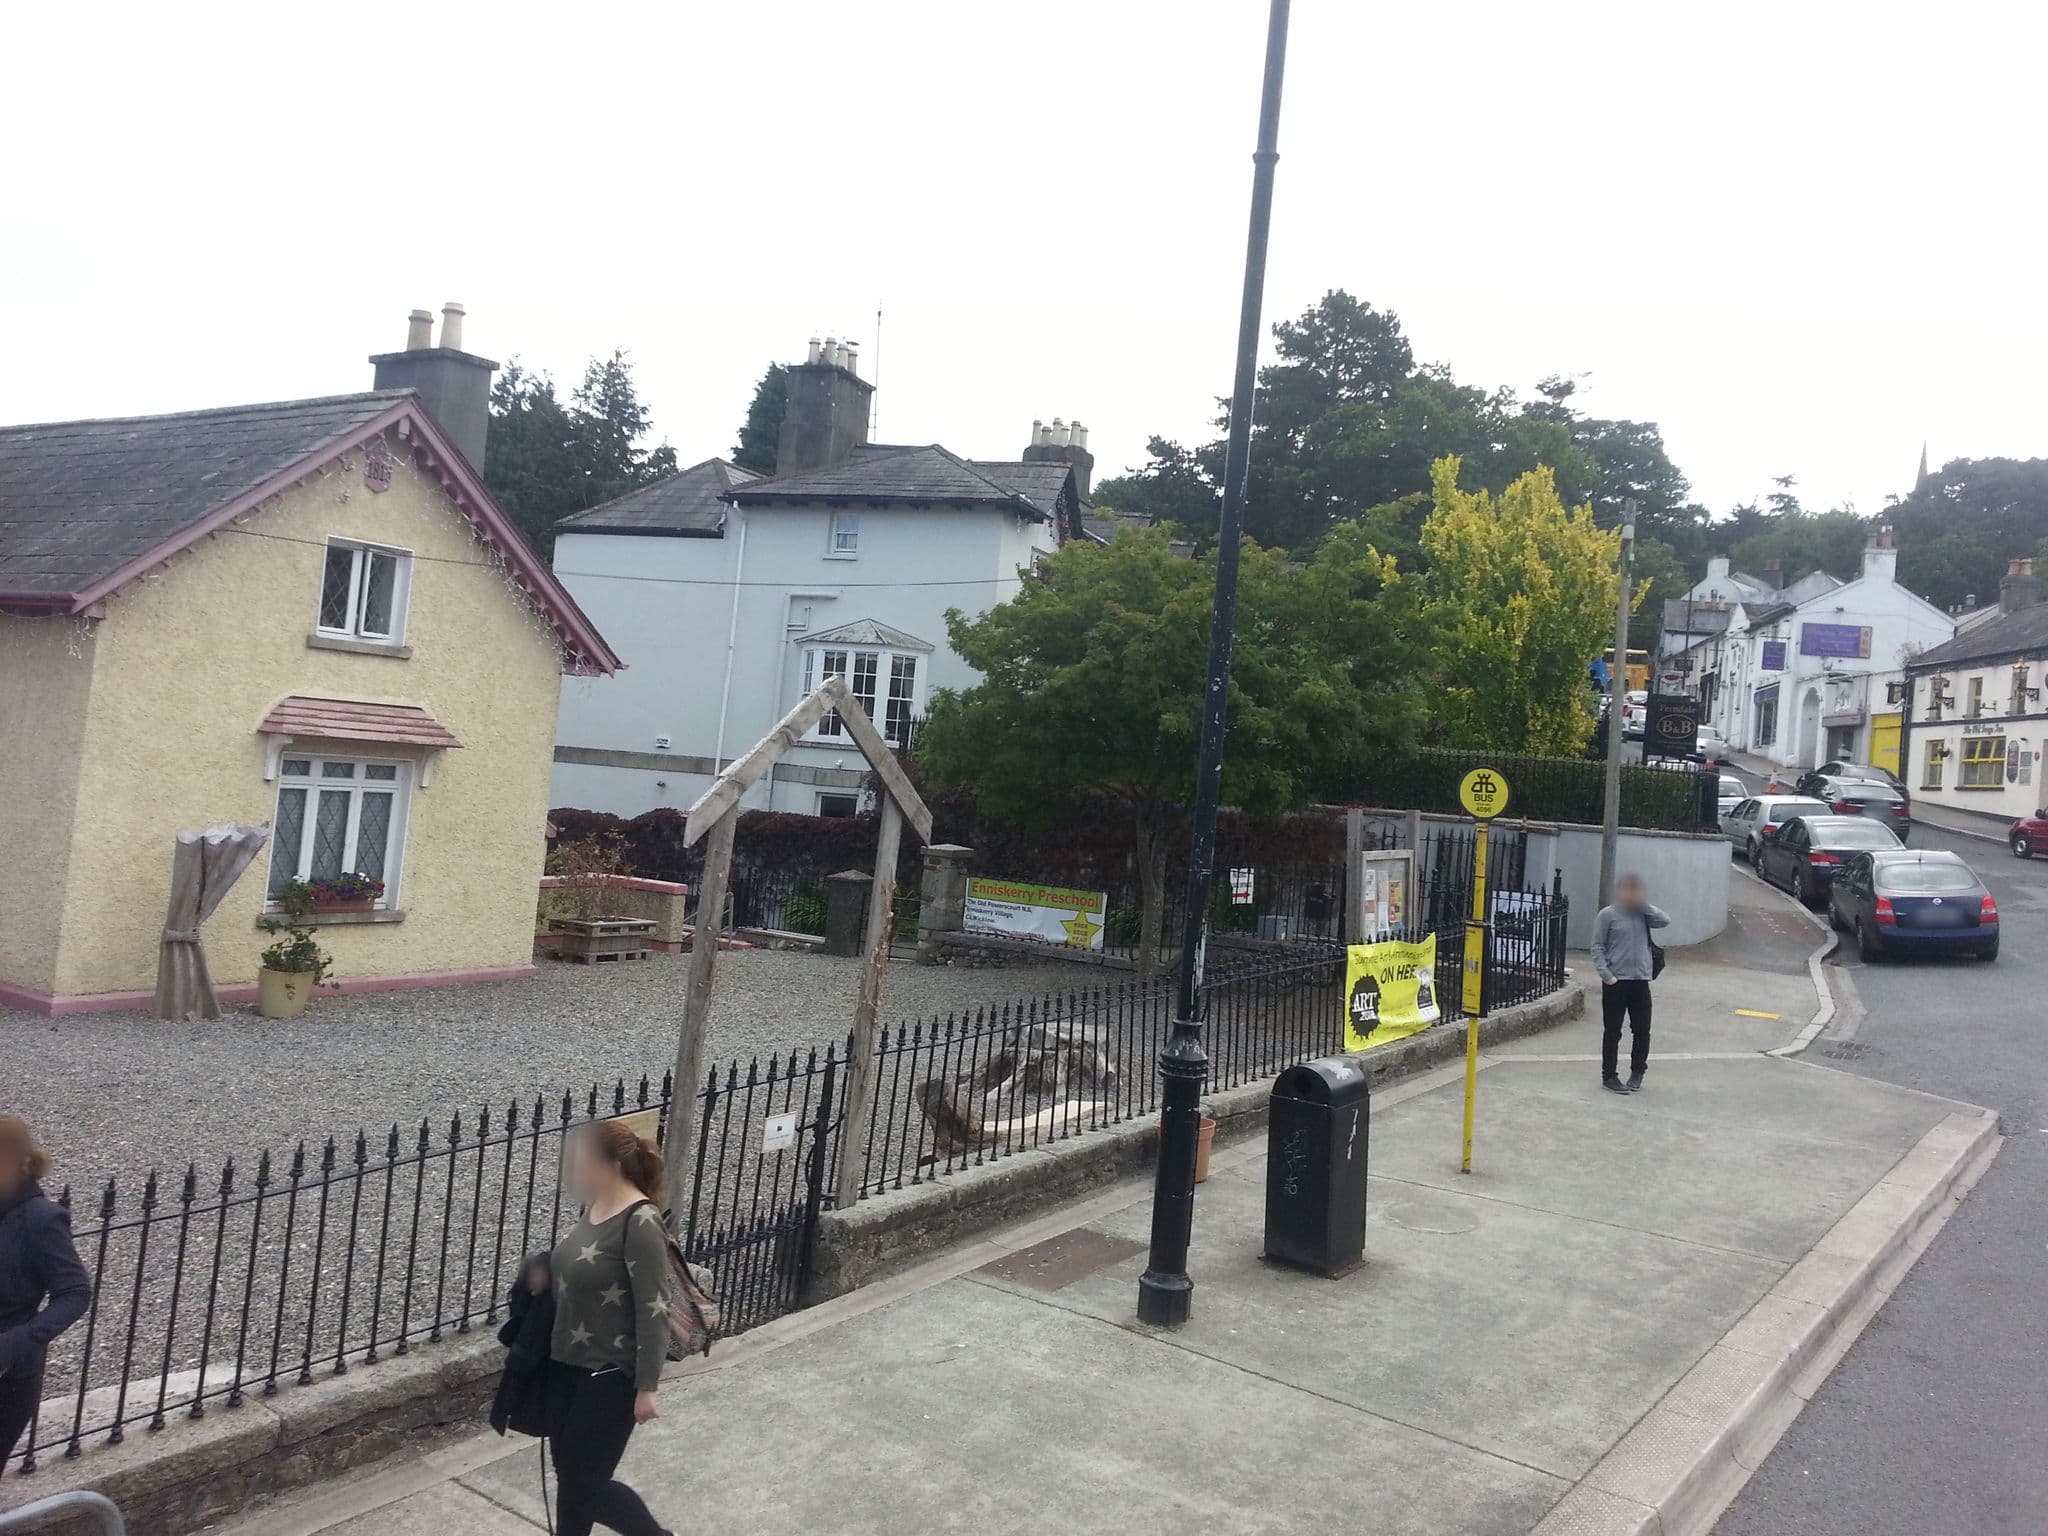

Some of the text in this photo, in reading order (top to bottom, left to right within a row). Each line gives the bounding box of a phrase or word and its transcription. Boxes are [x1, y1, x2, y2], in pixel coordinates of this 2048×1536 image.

[1662, 720, 1692, 734] B&B
[1474, 794, 1494, 803] BUS
[972, 881, 1099, 908] Enniskerry Preschool
[987, 901, 1020, 911] Powerscourt
[1380, 964, 1418, 984] ON HER
[1352, 992, 1378, 1012] ART
